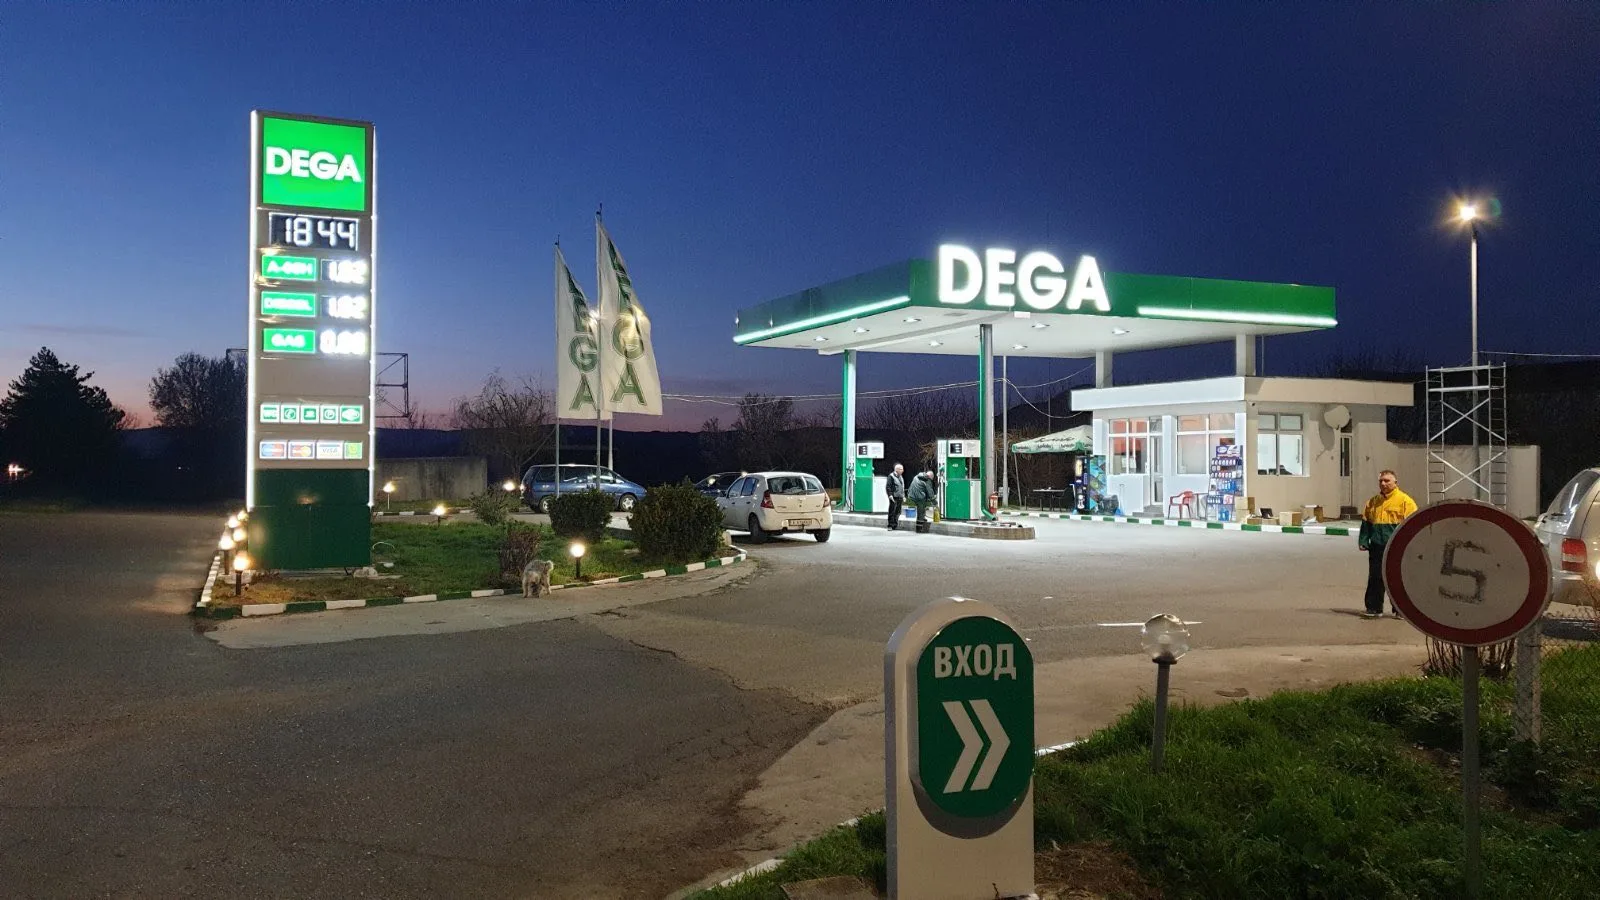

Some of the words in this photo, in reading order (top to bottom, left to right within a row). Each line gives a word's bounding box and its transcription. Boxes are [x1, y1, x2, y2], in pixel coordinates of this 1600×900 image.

[266, 146, 362, 183] DEGA
[938, 244, 1111, 312] DEGA
[1438, 539, 1491, 605] 5
[934, 643, 1016, 681] ВХОД
